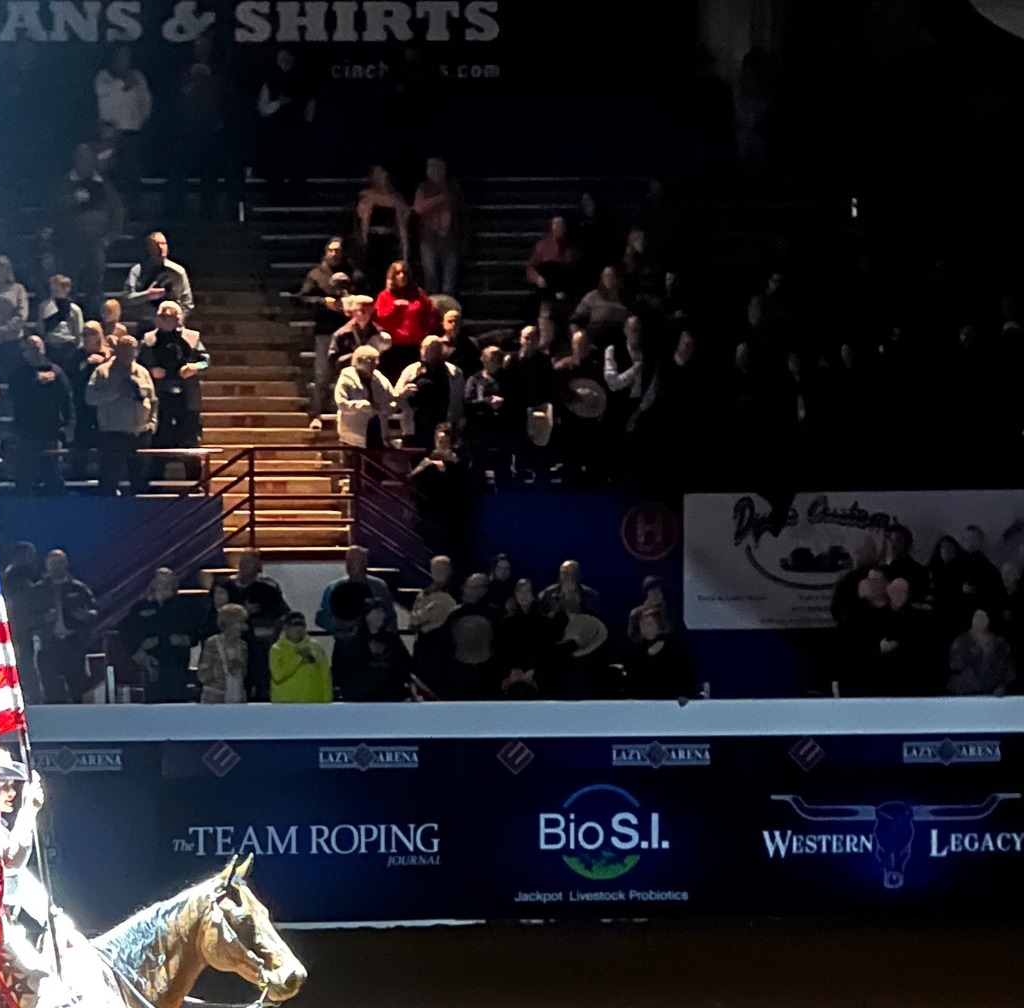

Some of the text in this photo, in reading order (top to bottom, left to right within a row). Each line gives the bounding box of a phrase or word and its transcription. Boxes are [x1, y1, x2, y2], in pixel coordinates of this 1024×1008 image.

[161, 1, 216, 42] &
[234, 0, 500, 42] SHIRTS
[319, 751, 418, 763] LAZY ARENA
[612, 748, 711, 761] LAZY ARENA
[959, 746, 1001, 757] ARENA
[79, 754, 122, 765] ARENA
[172, 823, 441, 856] The TEAM ROPING
[762, 830, 873, 858] WESTERN
[387, 854, 442, 868] JOURNAL
[514, 889, 689, 904] Jackpot Livestock Probiotics
